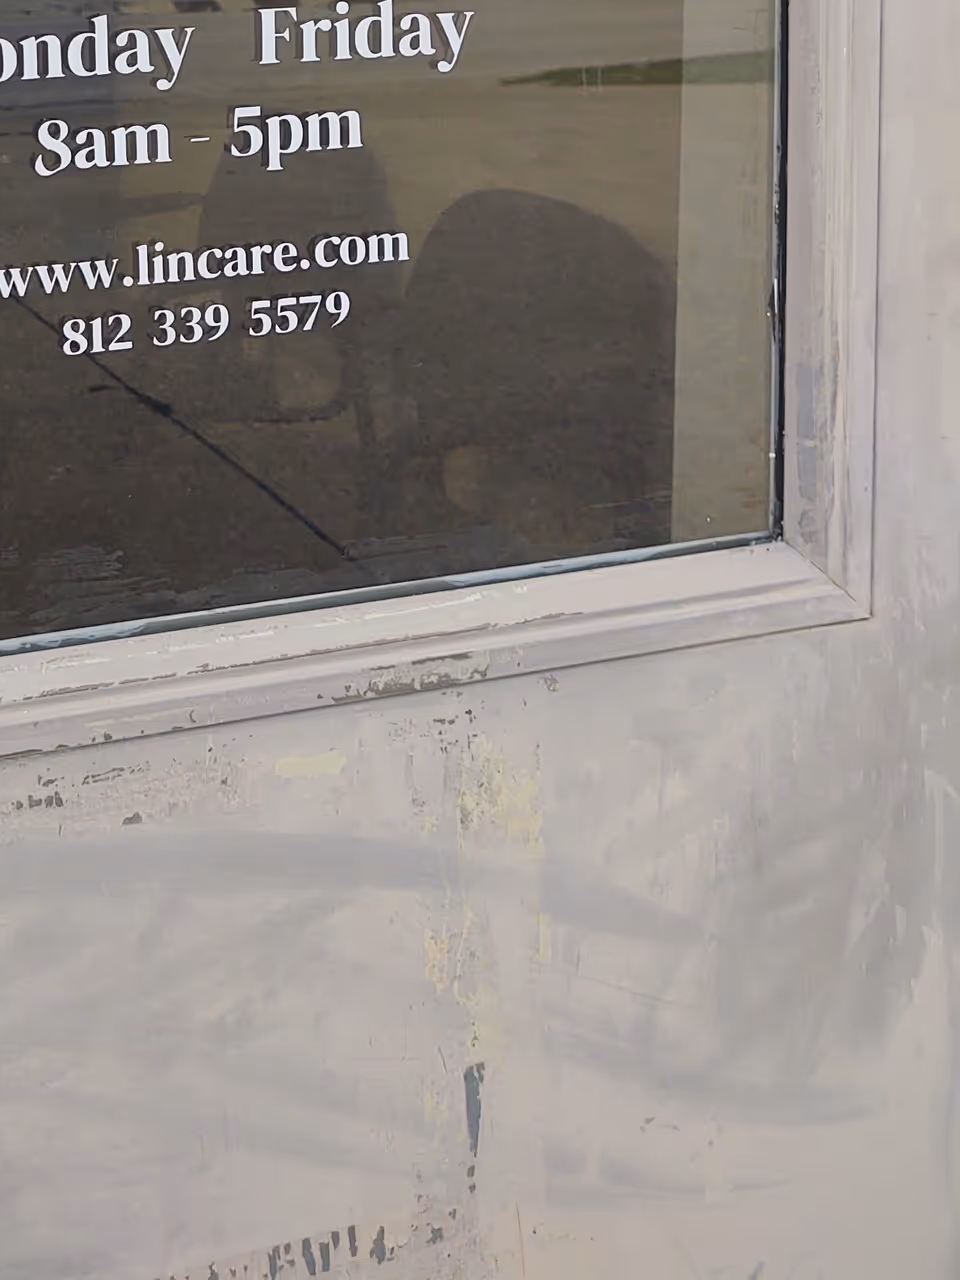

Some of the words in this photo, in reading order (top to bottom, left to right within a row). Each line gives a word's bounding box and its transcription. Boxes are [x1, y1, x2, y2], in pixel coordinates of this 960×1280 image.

[34, 118, 173, 177] 8am
[230, 105, 364, 171] 5pm
[61, 313, 133, 356] 812
[152, 304, 230, 346] 339
[248, 290, 351, 336] 5579
